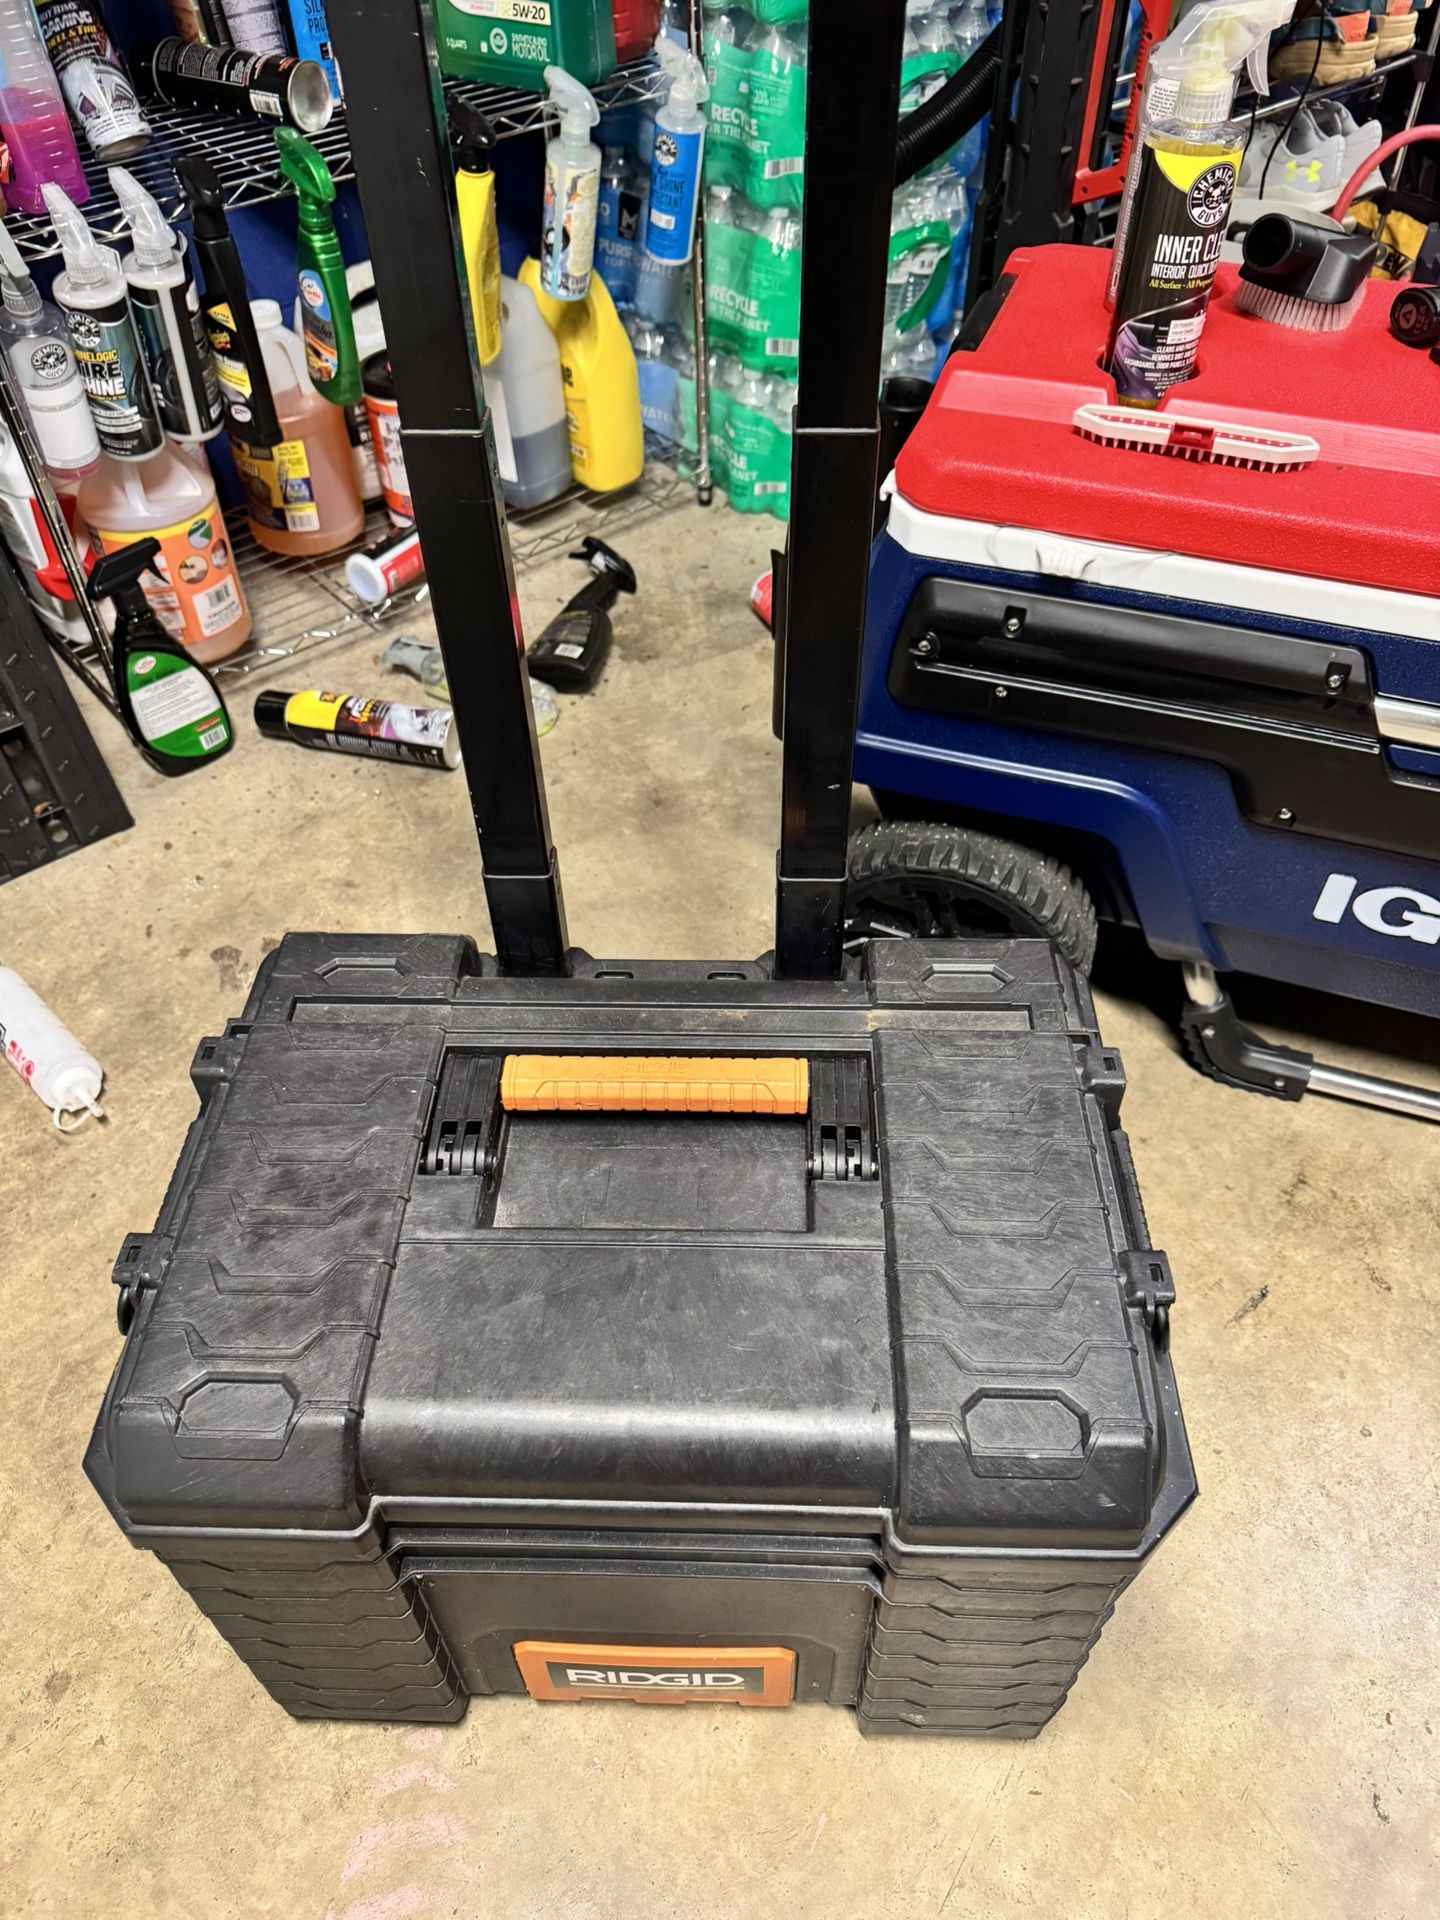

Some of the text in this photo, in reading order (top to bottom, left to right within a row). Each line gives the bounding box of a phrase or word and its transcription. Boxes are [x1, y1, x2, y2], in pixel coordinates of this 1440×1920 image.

[53, 1, 78, 14] RIMS
[303, 0, 325, 15] SIL
[512, 3, 546, 20] 5W-20
[41, 10, 93, 40] OAMING
[307, 15, 327, 34] PRO
[1193, 168, 1235, 195] CHEMICAL
[1197, 207, 1224, 223] GUYS
[1154, 230, 1225, 264] INNER CLE
[1150, 262, 1187, 279] INTERIOR
[1188, 262, 1211, 279] QUICK
[1149, 278, 1159, 288] All
[1160, 279, 1182, 290] Surface
[1186, 278, 1195, 289] All
[32, 344, 66, 366] CHEMICAL
[73, 349, 118, 363] INELOGIC
[84, 378, 127, 397] HINE
[623, 1060, 690, 1074] RIDGID
[566, 1668, 745, 1687] RIDGID
